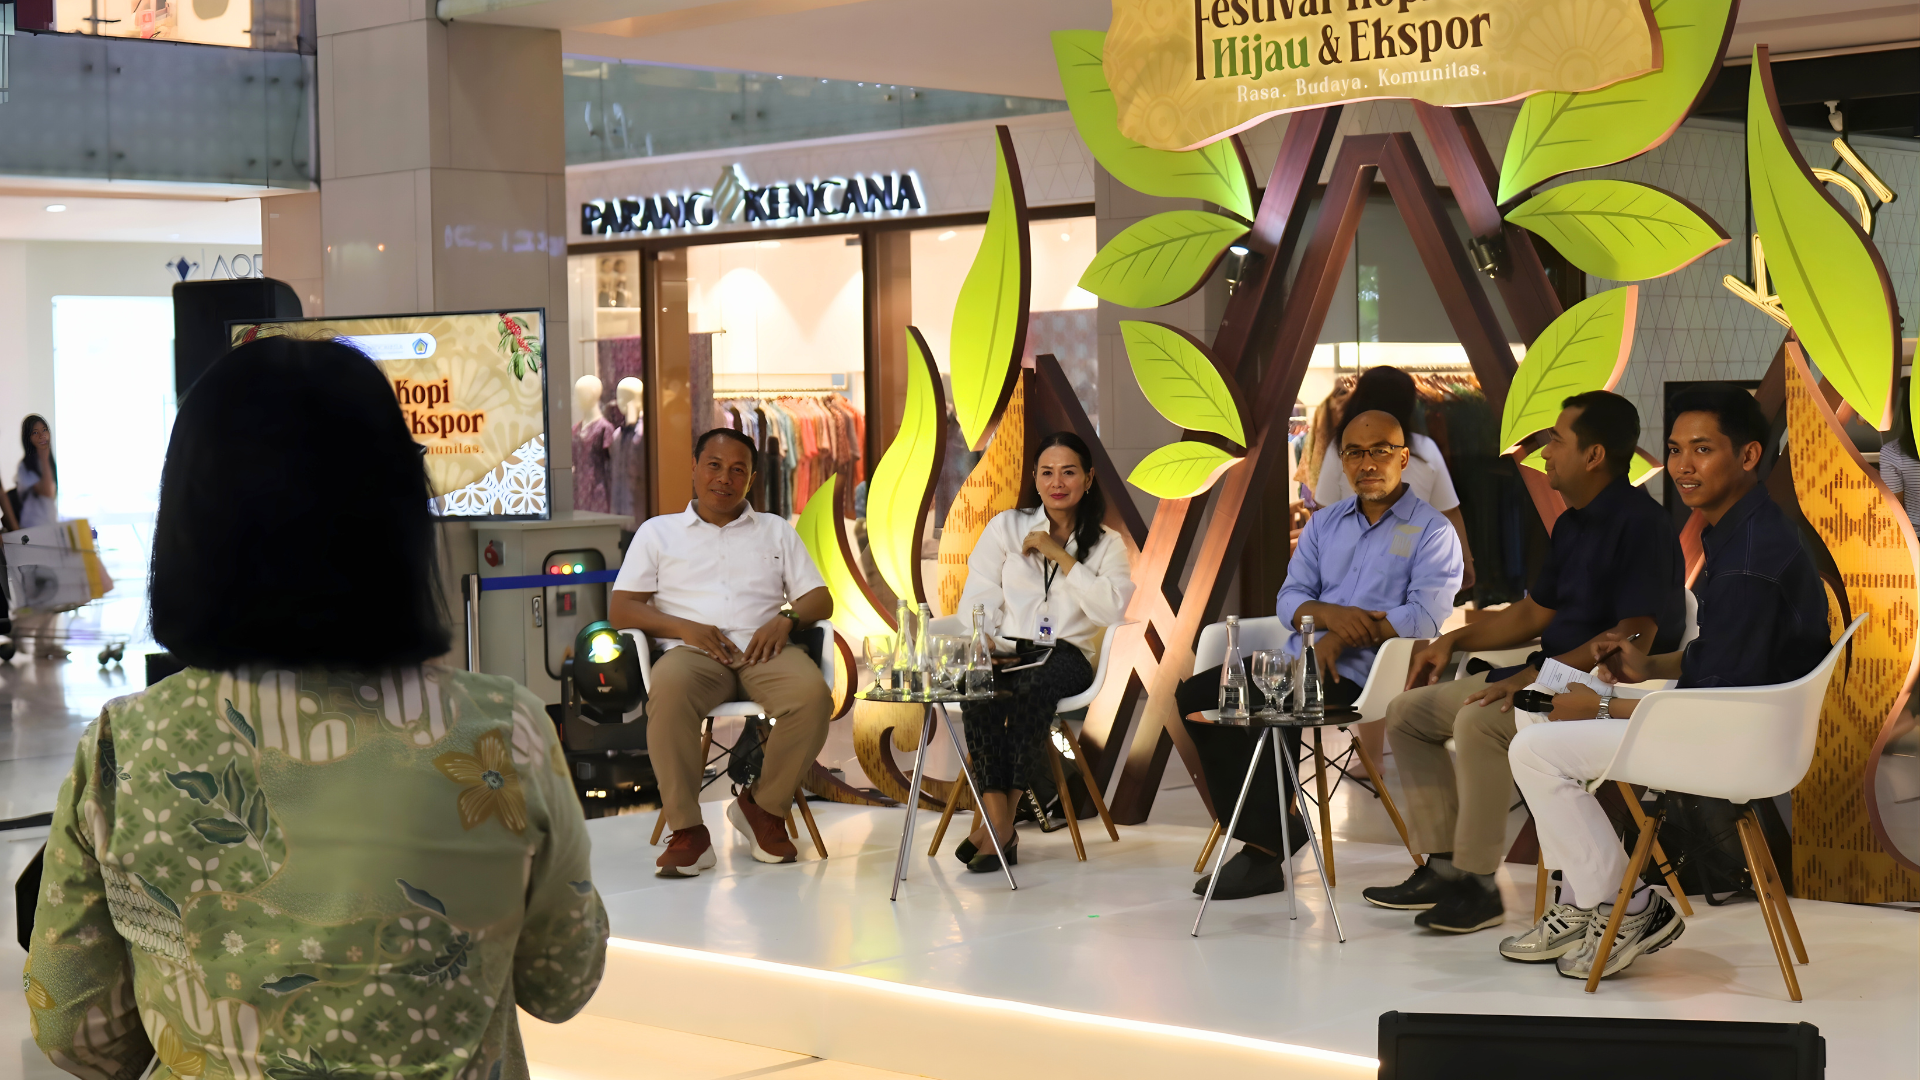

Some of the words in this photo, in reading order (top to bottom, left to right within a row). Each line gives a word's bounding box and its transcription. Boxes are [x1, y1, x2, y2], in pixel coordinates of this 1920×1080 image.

[1212, 33, 1310, 80] Hijau
[1318, 24, 1343, 66] &
[1348, 12, 1491, 63] Ekspor
[1237, 84, 1287, 103] Rasa.
[1296, 76, 1368, 97] Budaya.
[1378, 62, 1487, 87] Komunitas.
[581, 191, 714, 236] PARANG
[743, 172, 922, 223] KENCANA
[395, 378, 451, 410] Kopi
